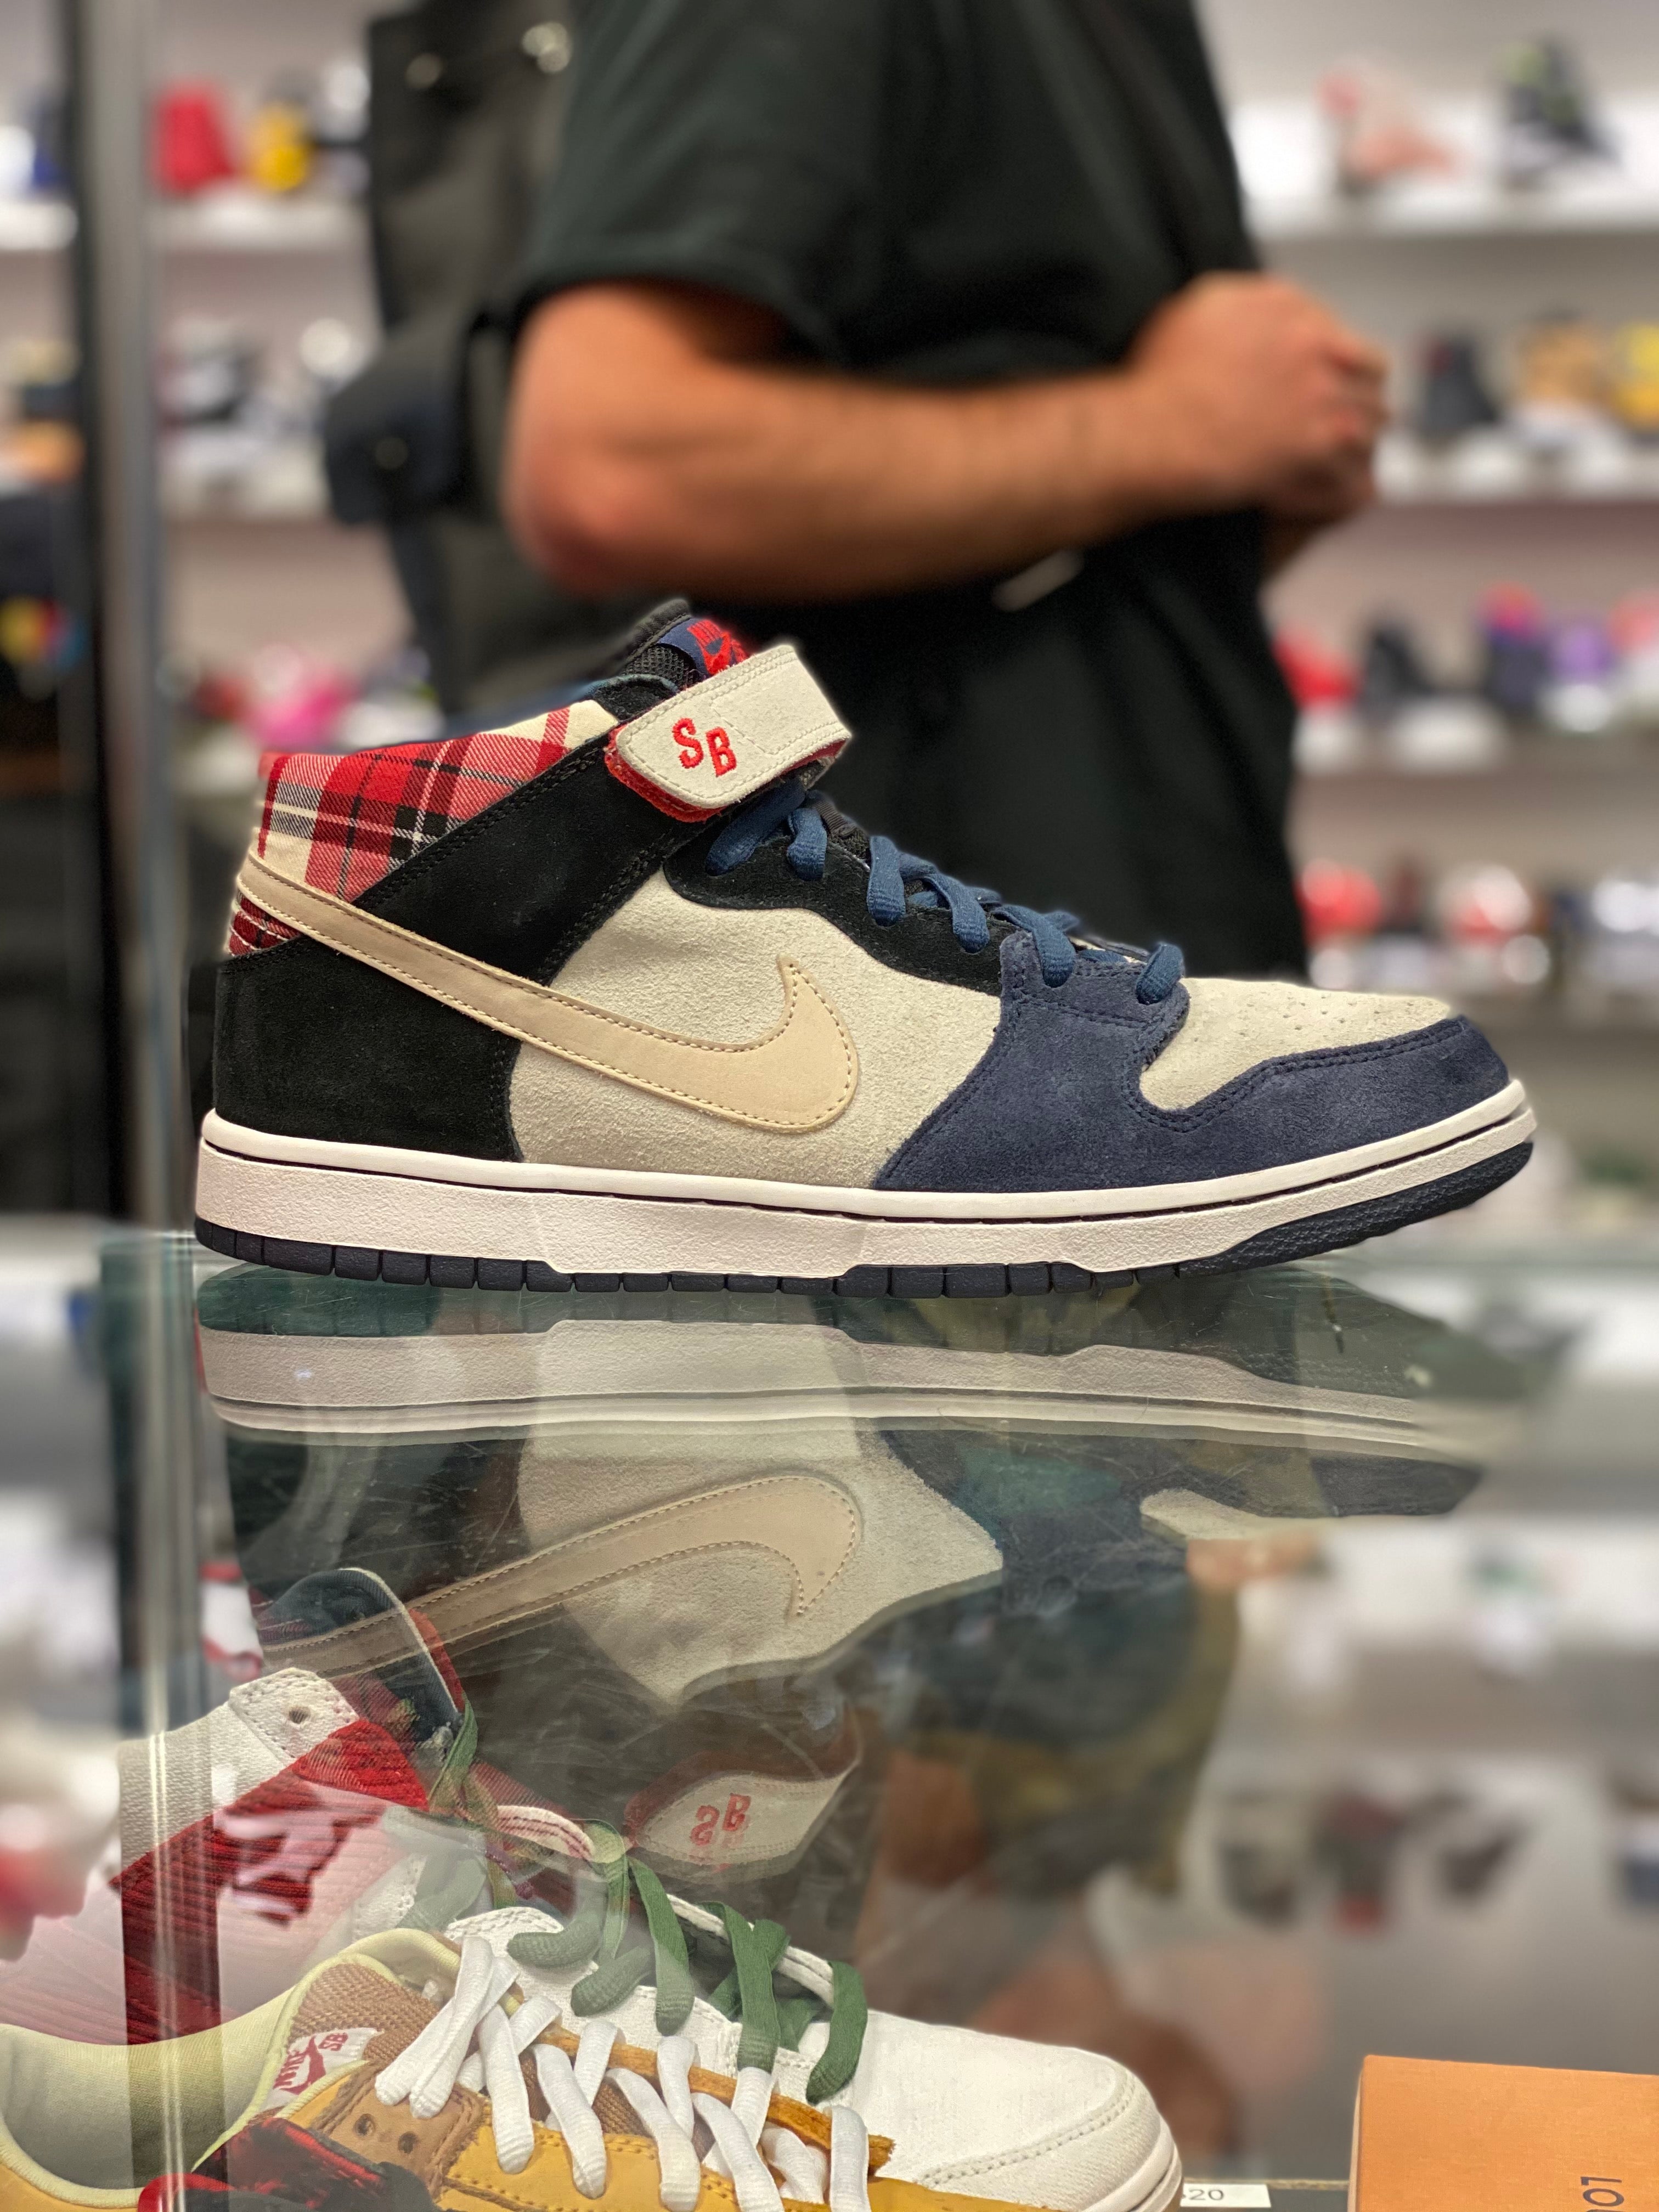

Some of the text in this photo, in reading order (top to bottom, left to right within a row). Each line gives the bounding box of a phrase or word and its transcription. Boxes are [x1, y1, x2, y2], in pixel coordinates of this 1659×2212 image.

[672, 718, 736, 777] SB
[318, 2033, 348, 2051] SB
[1182, 2189, 1224, 2201] 20
[1580, 2176, 1625, 2212] 01
